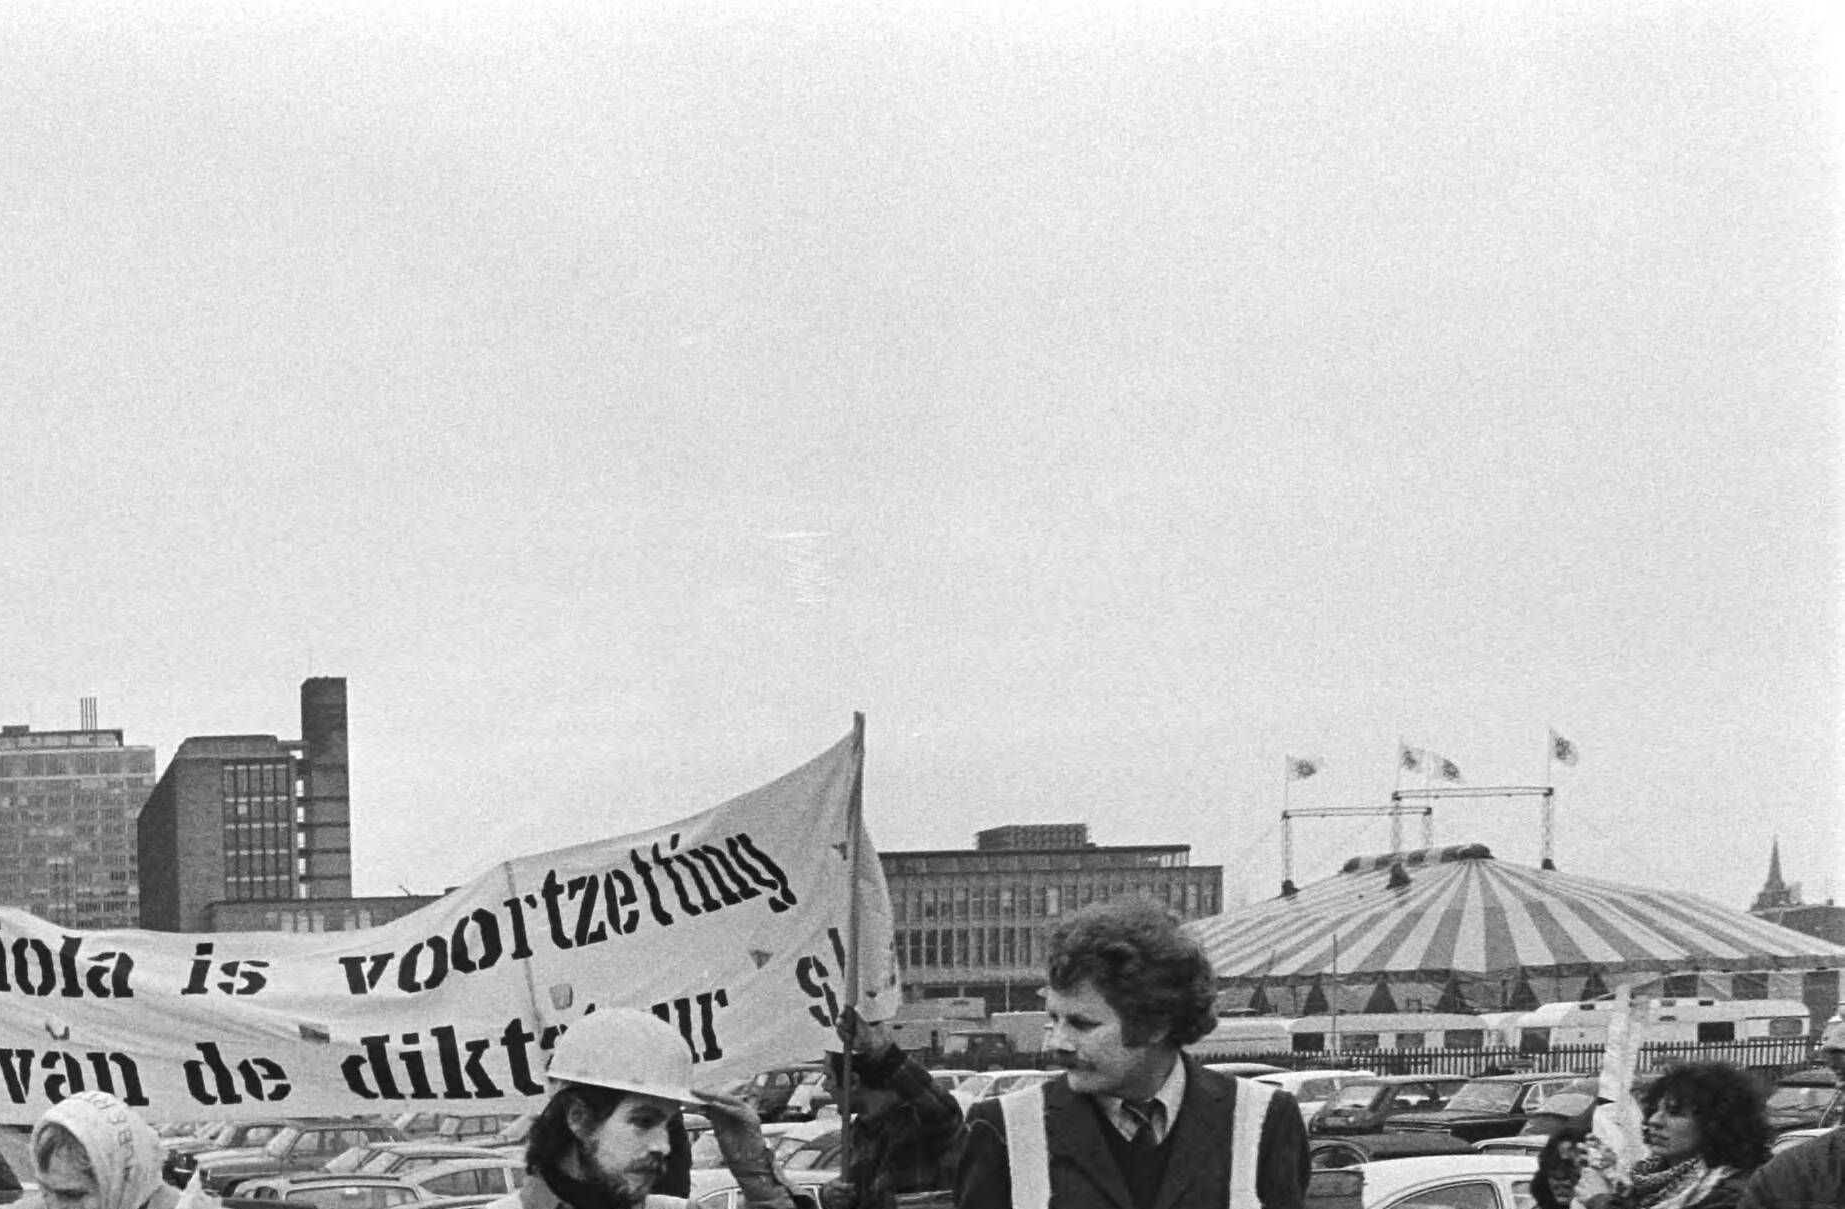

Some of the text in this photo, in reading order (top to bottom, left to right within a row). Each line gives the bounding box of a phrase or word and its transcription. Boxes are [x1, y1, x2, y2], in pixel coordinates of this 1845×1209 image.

[182, 942, 270, 996] is
[340, 831, 797, 995] voortzetting
[184, 1042, 292, 1105] de
